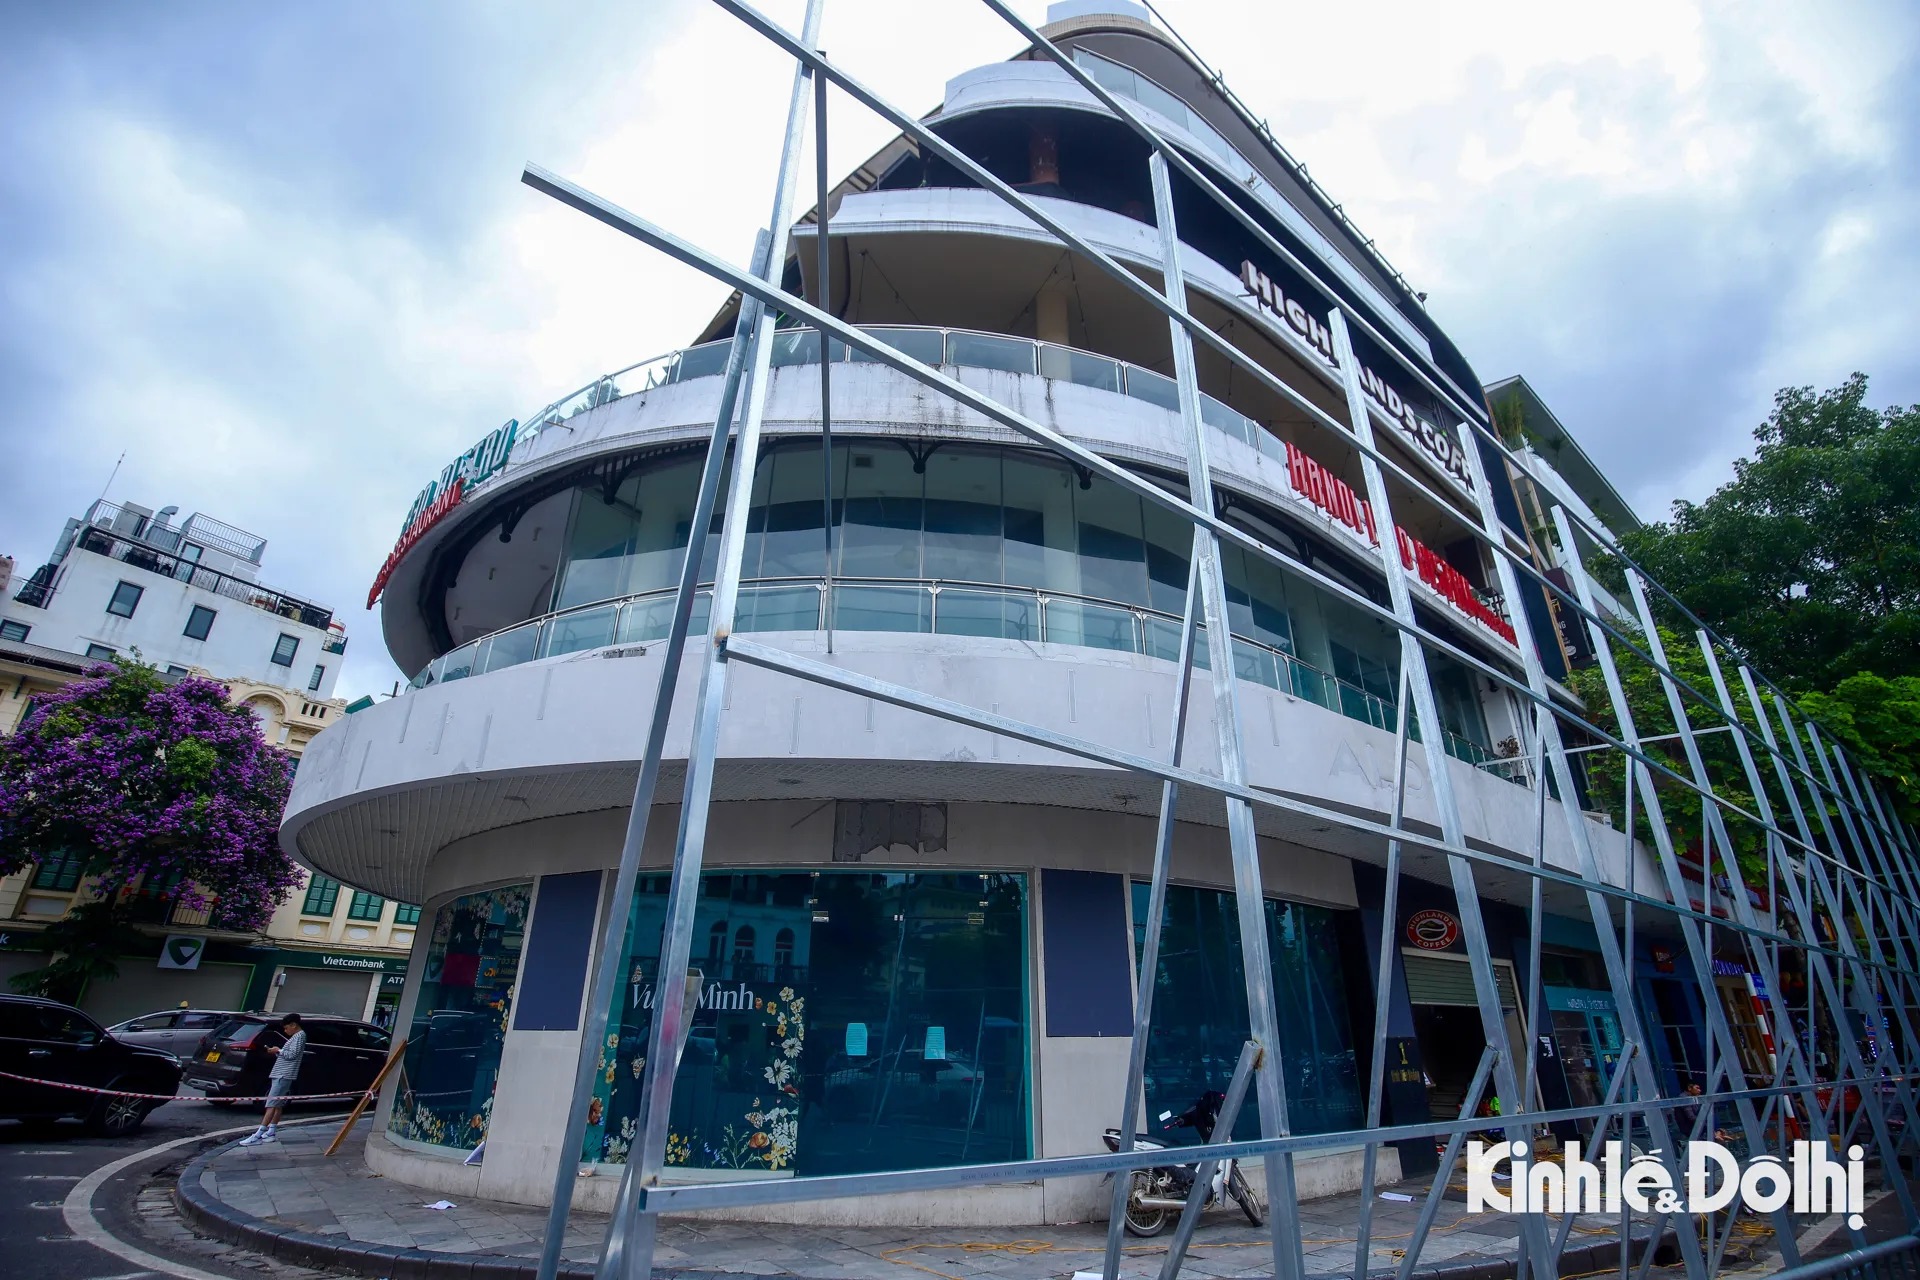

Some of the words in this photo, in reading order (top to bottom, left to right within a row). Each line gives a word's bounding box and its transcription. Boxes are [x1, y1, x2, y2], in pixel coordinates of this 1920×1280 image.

[1240, 259, 1416, 431] HIGHANDS
[1285, 441, 1363, 534] HANOI
[1409, 911, 1453, 930] HIGHLANDS
[1417, 936, 1452, 948] COFFEE
[322, 955, 385, 969] Vietcombank
